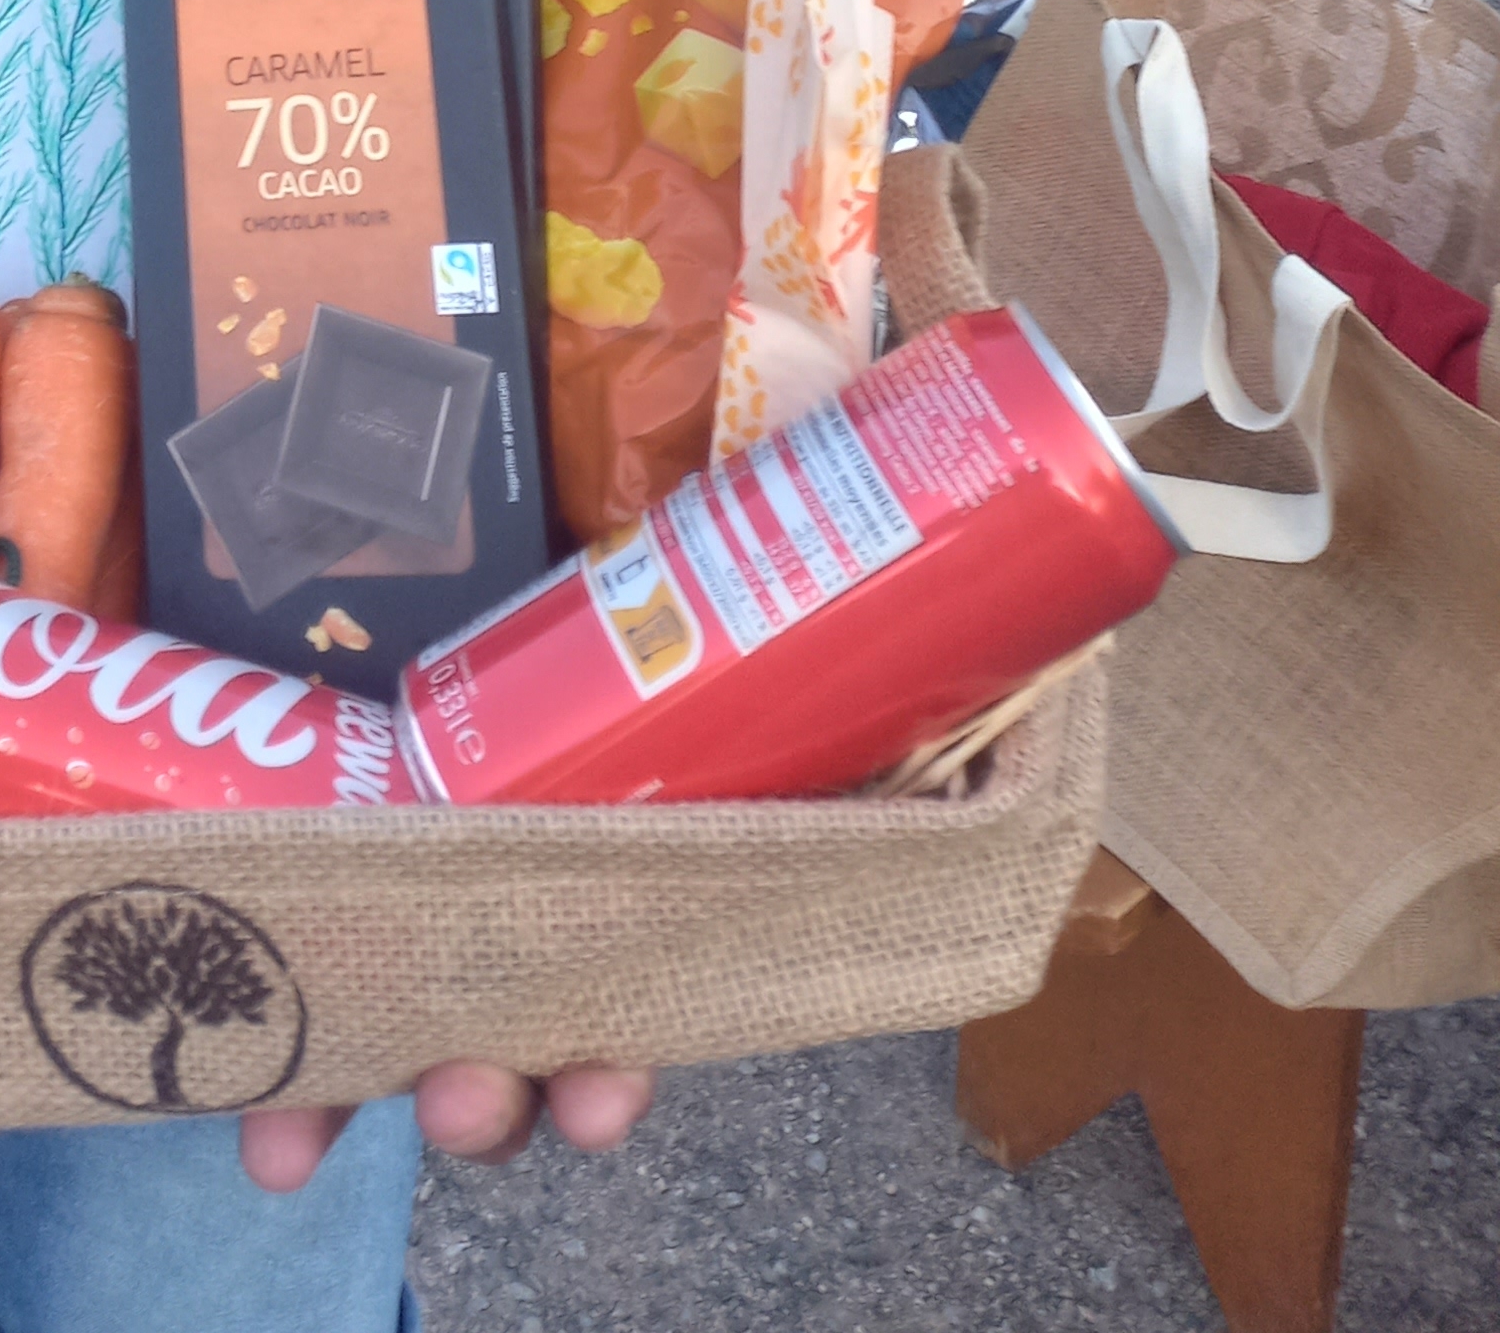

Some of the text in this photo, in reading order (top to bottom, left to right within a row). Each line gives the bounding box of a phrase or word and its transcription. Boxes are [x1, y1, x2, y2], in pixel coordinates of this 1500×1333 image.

[225, 47, 387, 86] CARAMEL
[225, 90, 391, 169] 70%
[257, 166, 363, 200] CACAO
